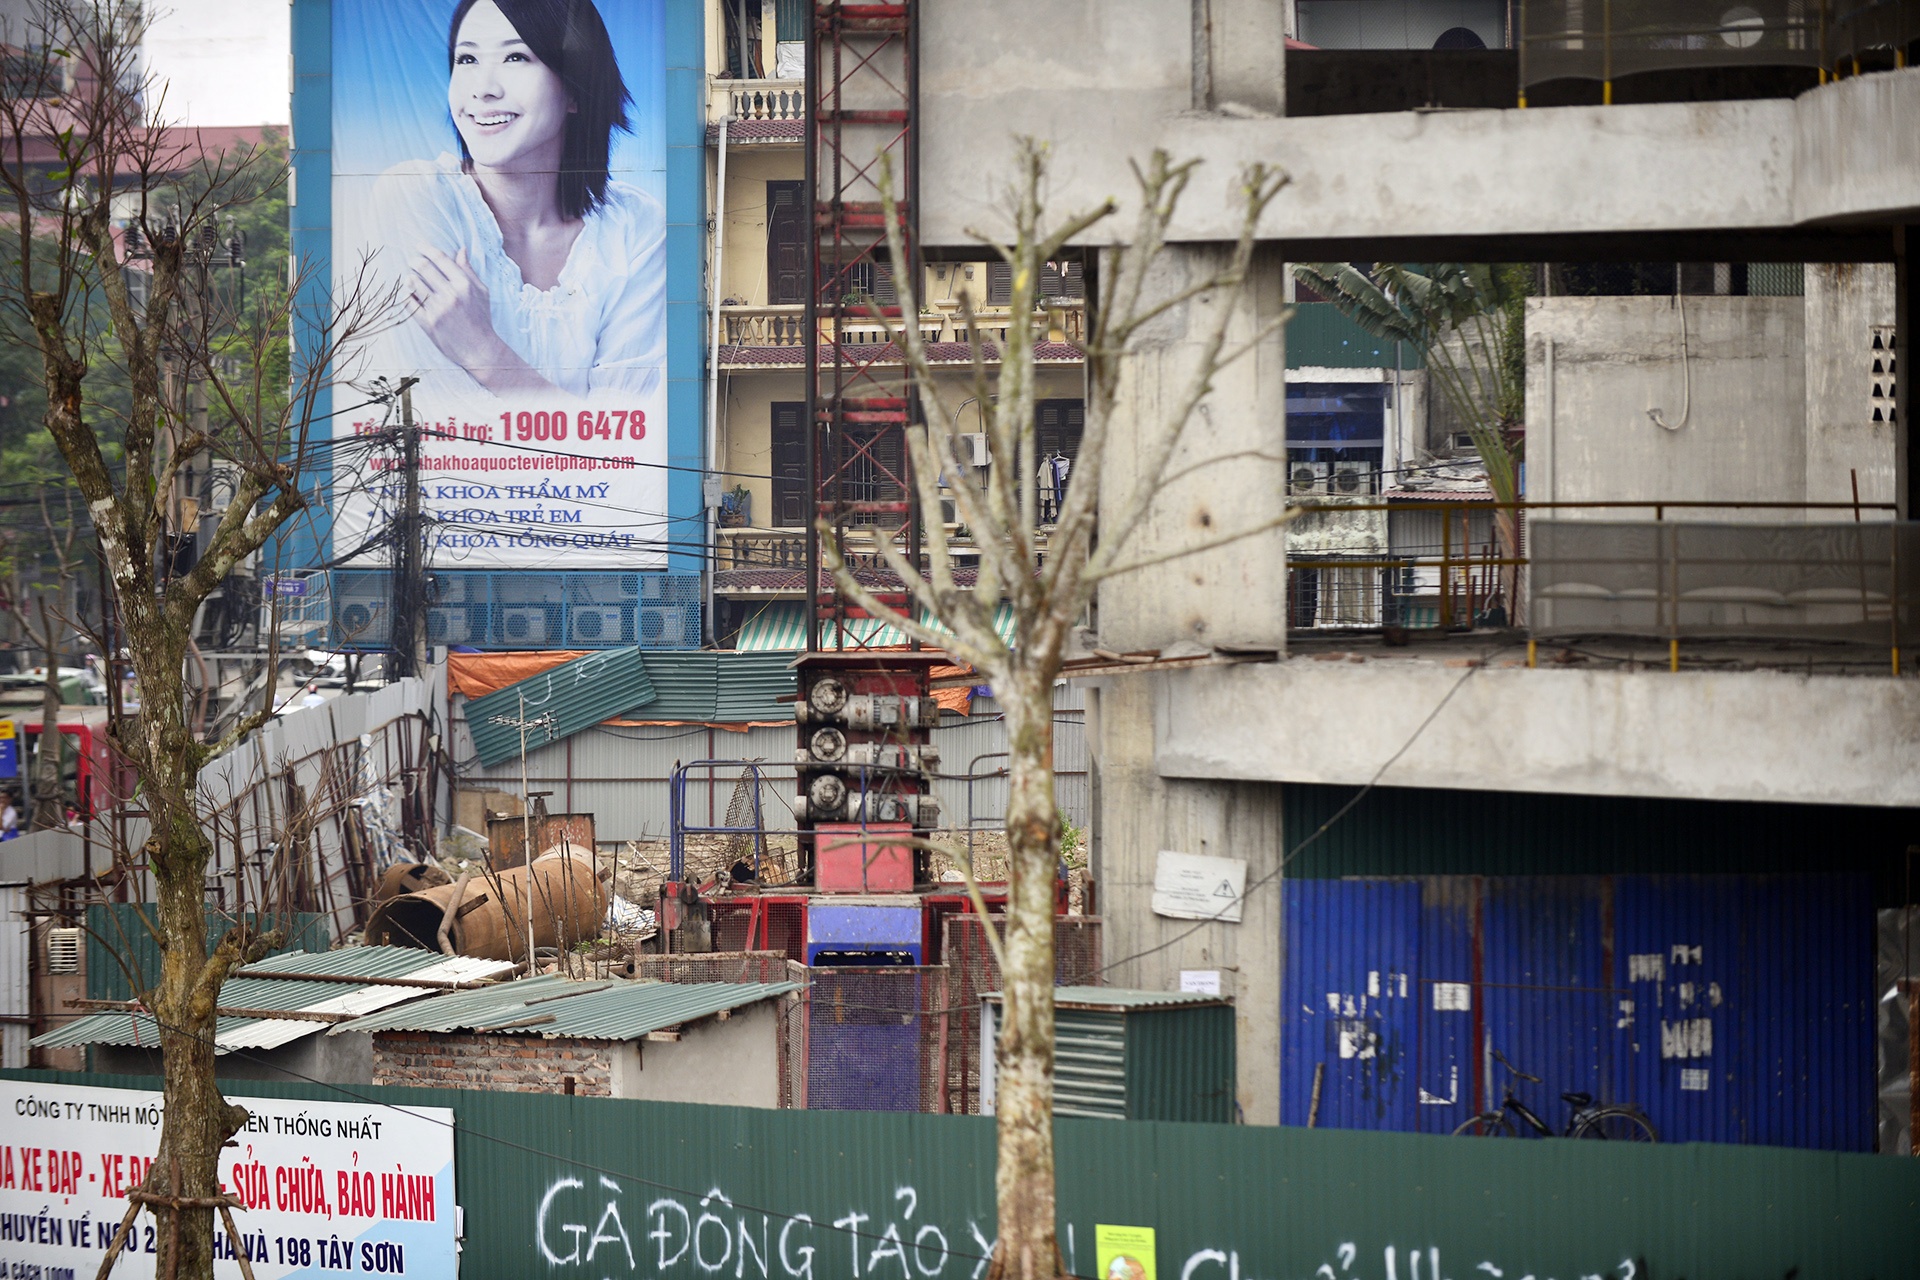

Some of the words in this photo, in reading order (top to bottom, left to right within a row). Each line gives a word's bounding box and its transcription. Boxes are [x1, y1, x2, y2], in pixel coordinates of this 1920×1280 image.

[436, 416, 457, 442] hỗ
[463, 423, 493, 446] trợ:
[500, 411, 567, 441] 1900
[577, 410, 646, 441] 6478
[437, 485, 500, 500] KHOA
[505, 478, 571, 499] THẨM
[576, 482, 610, 499] MỸ
[437, 510, 500, 524] KHOA
[505, 503, 545, 524] TRẺ
[549, 510, 582, 523] EM
[437, 534, 500, 548] KHOA
[505, 527, 567, 548] TỔNG
[573, 530, 635, 549] QUÁT
[15, 1095, 60, 1119] CÔNG
[64, 1102, 83, 1120] TY
[88, 1103, 130, 1124] TNHH
[135, 1098, 164, 1130] MỘ
[273, 1110, 332, 1137] THỐNG
[337, 1114, 382, 1140] NHẤT
[20, 1147, 43, 1192] XE
[47, 1149, 83, 1205] ĐẠP
[101, 1153, 125, 1199] XE
[232, 1144, 271, 1211] SỬA
[275, 1156, 332, 1221] CHỮA,
[337, 1151, 375, 1218] BẢO
[381, 1163, 436, 1223] HÀNH
[0, 1205, 62, 1247] HUYỂN
[243, 1229, 269, 1264] VÀ
[275, 1236, 311, 1268] 198
[317, 1234, 354, 1270] TÂY
[361, 1242, 404, 1275] SƠN
[535, 1174, 636, 1271] GÀ
[648, 1184, 816, 1280] ĐÔNG
[832, 1185, 949, 1280] TẢO
